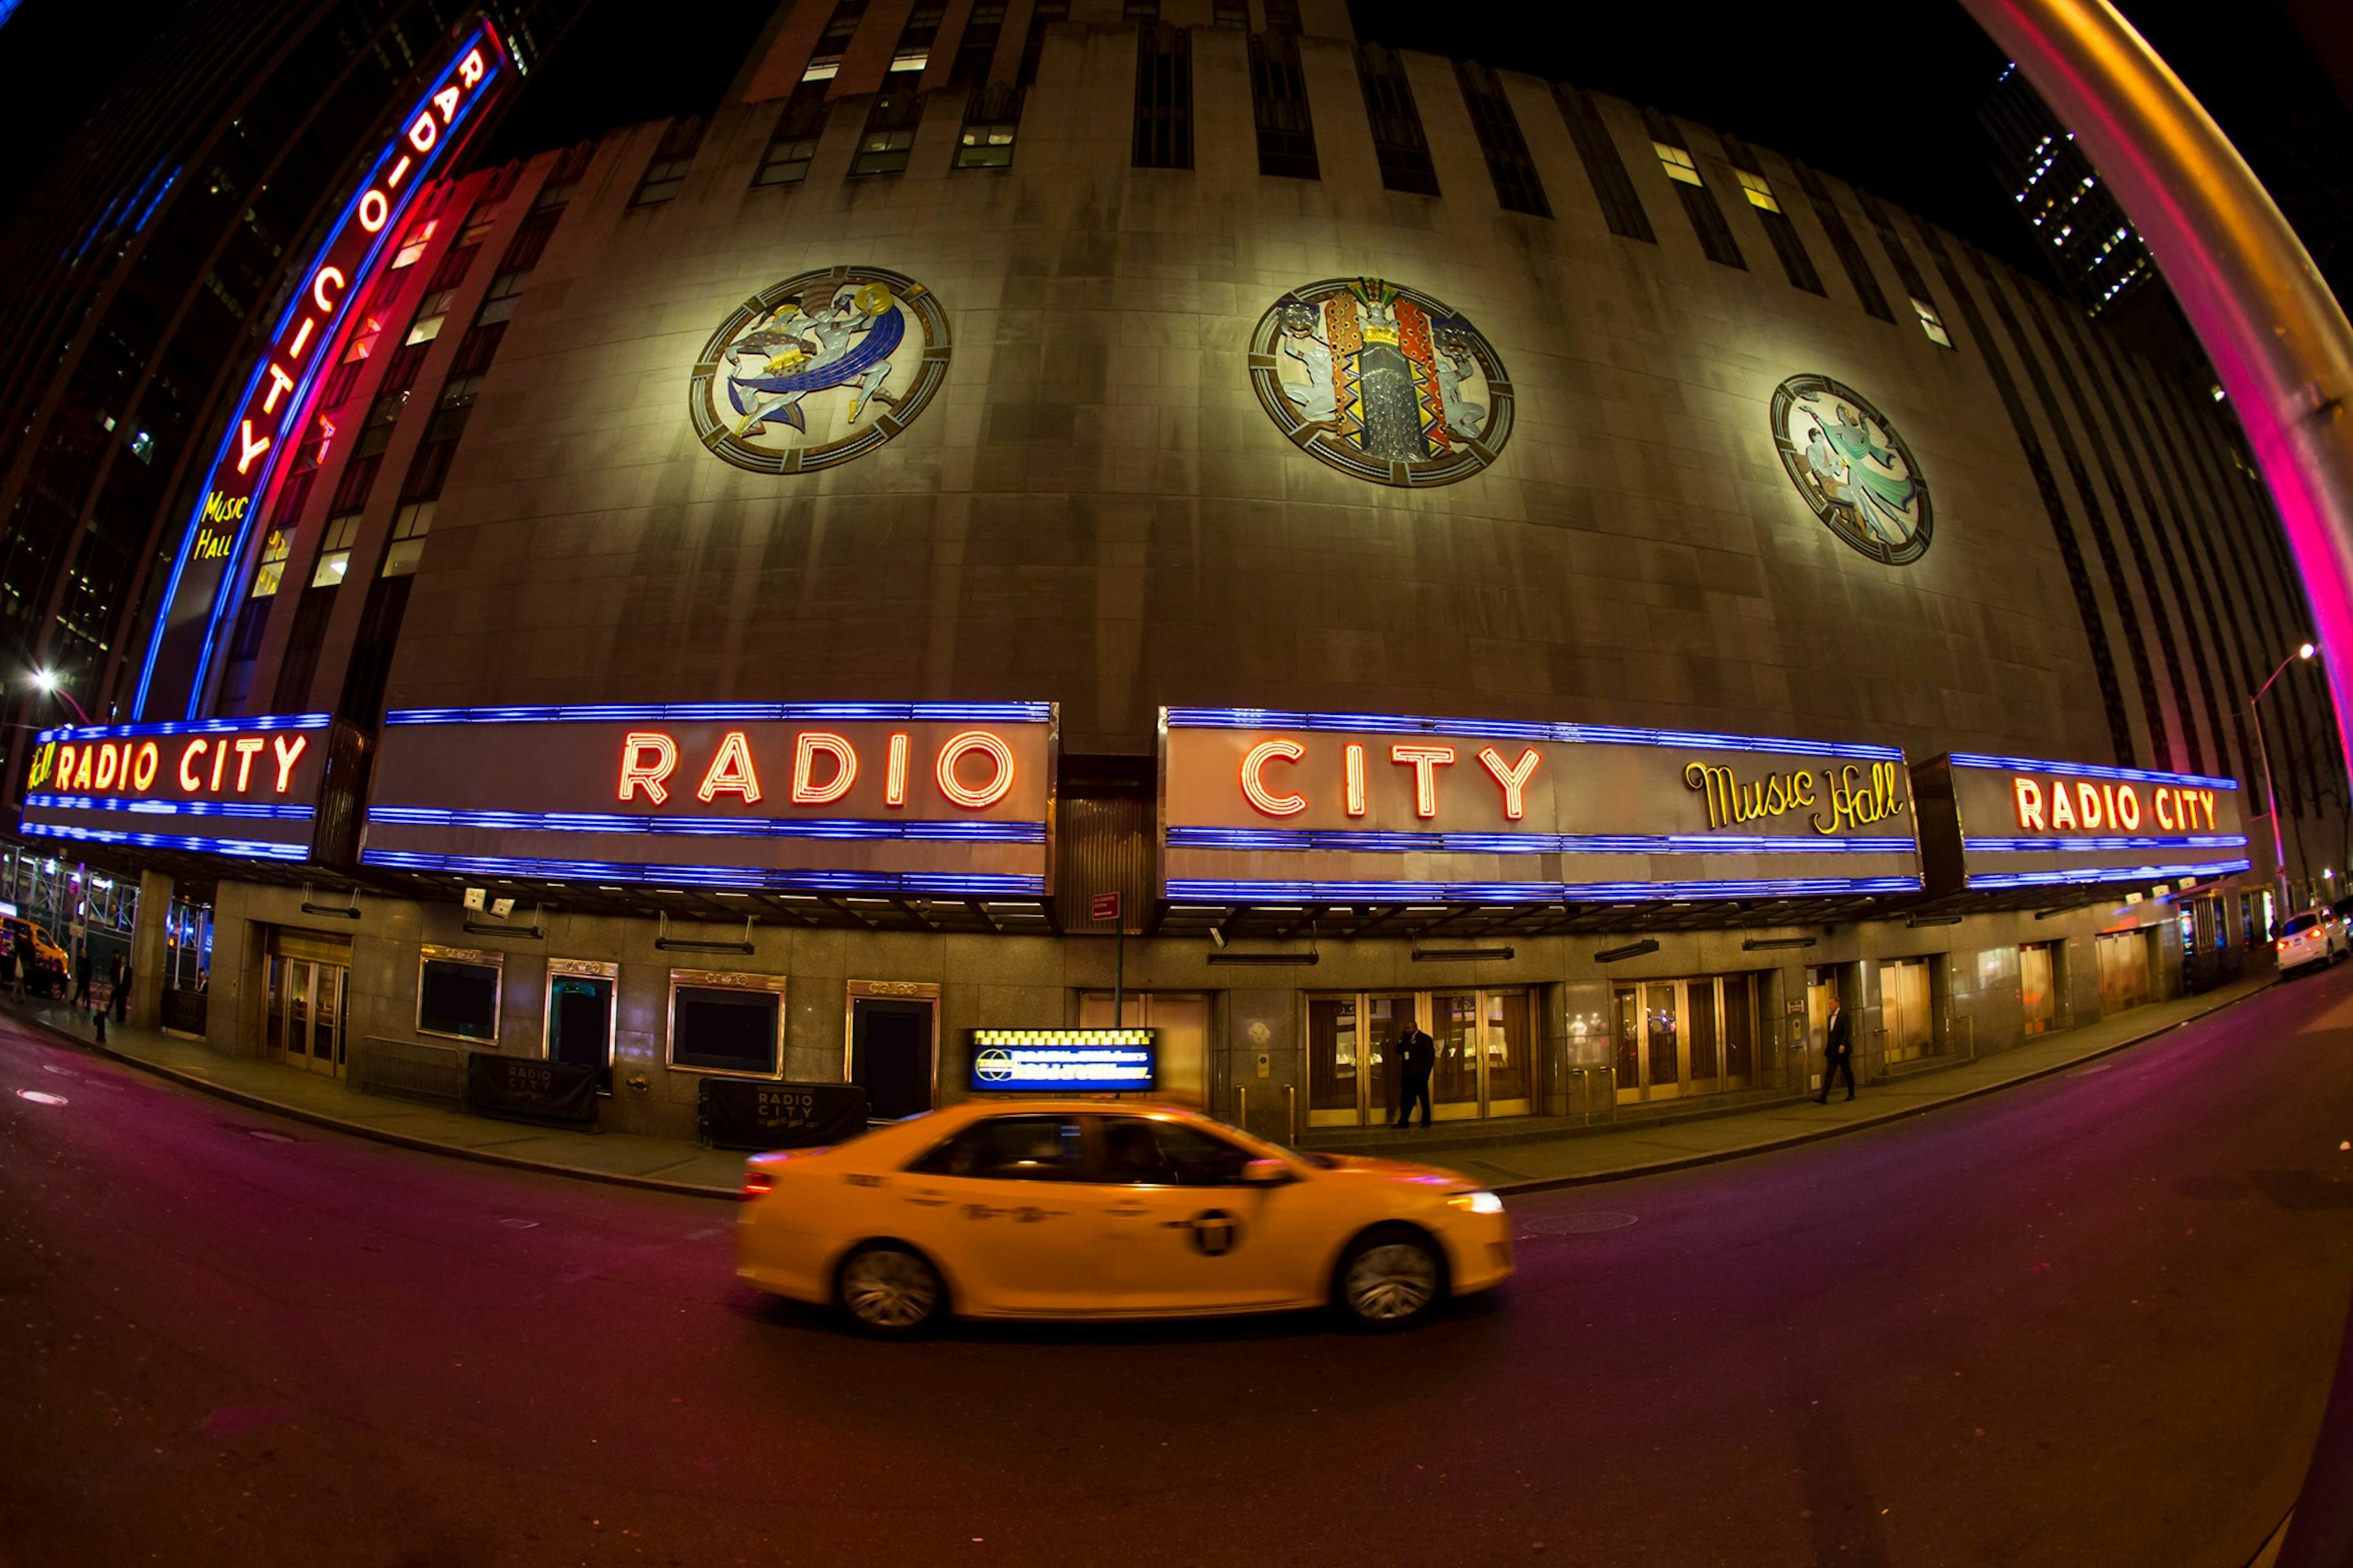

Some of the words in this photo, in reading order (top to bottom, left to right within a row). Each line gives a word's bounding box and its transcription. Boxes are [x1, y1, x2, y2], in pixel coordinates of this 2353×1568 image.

[358, 48, 484, 233] RADIO
[237, 266, 345, 475] CITY
[55, 740, 159, 791] RADIO
[179, 735, 306, 793] CITY
[617, 730, 1015, 808] RADIO
[1239, 737, 1542, 820] CITY
[1684, 760, 1815, 831] Music
[1813, 760, 1903, 835] Hall
[2013, 776, 2141, 831] RADIO
[2154, 787, 2215, 831] CITY
[509, 1066, 550, 1080] RADIO
[509, 1077, 550, 1091] CITY
[759, 1093, 813, 1106] RADIO
[758, 1105, 813, 1118] CITY
